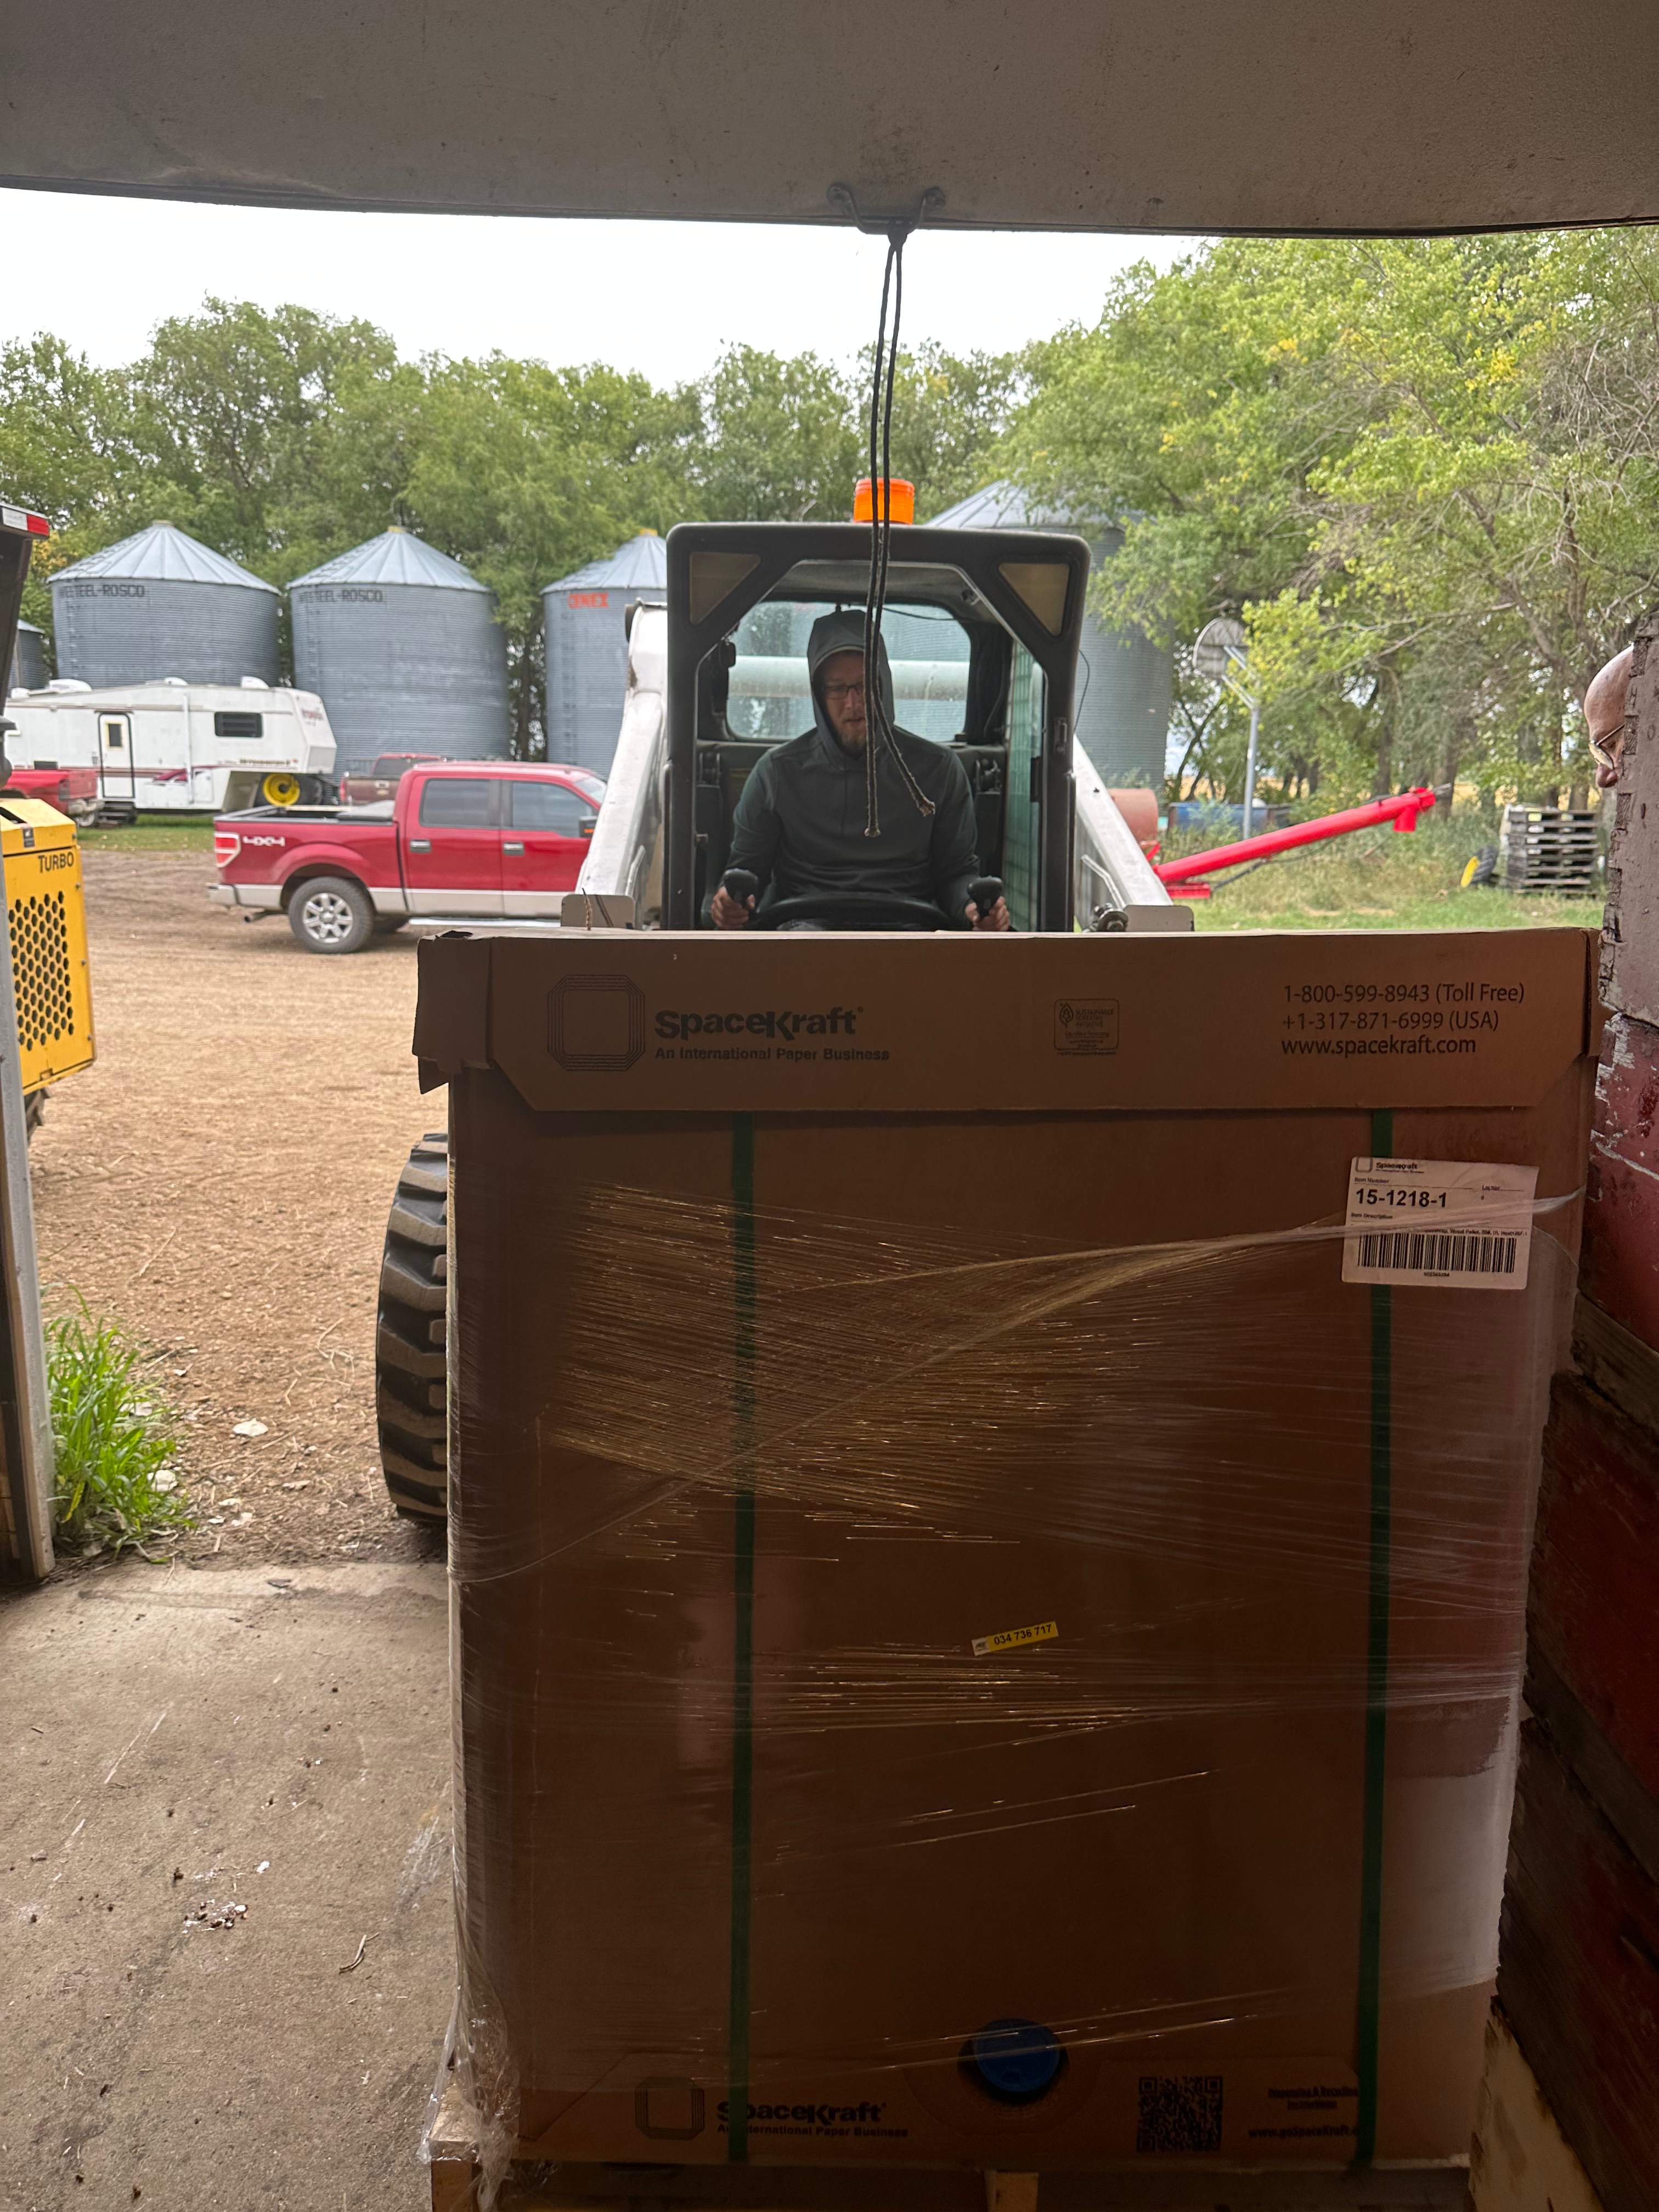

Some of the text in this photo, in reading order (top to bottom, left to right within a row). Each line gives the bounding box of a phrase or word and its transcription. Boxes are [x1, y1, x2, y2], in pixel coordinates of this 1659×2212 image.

[38, 851, 74, 873] TURBO
[1284, 982, 1525, 1005] 1-800-599-8943 (Toll Free)
[1282, 1009, 1499, 1032] +1-317-871-6999 (USA)
[654, 1047, 890, 1063] An International Paper Business
[1282, 1034, 1476, 1058] www.spacekraft.com
[1356, 1188, 1447, 1207] 15-1218-1
[994, 1624, 1051, 1645] 034 736 717
[748, 2126, 812, 2136] ternational
[816, 2127, 849, 2137] Paper
[854, 2127, 909, 2137] Business
